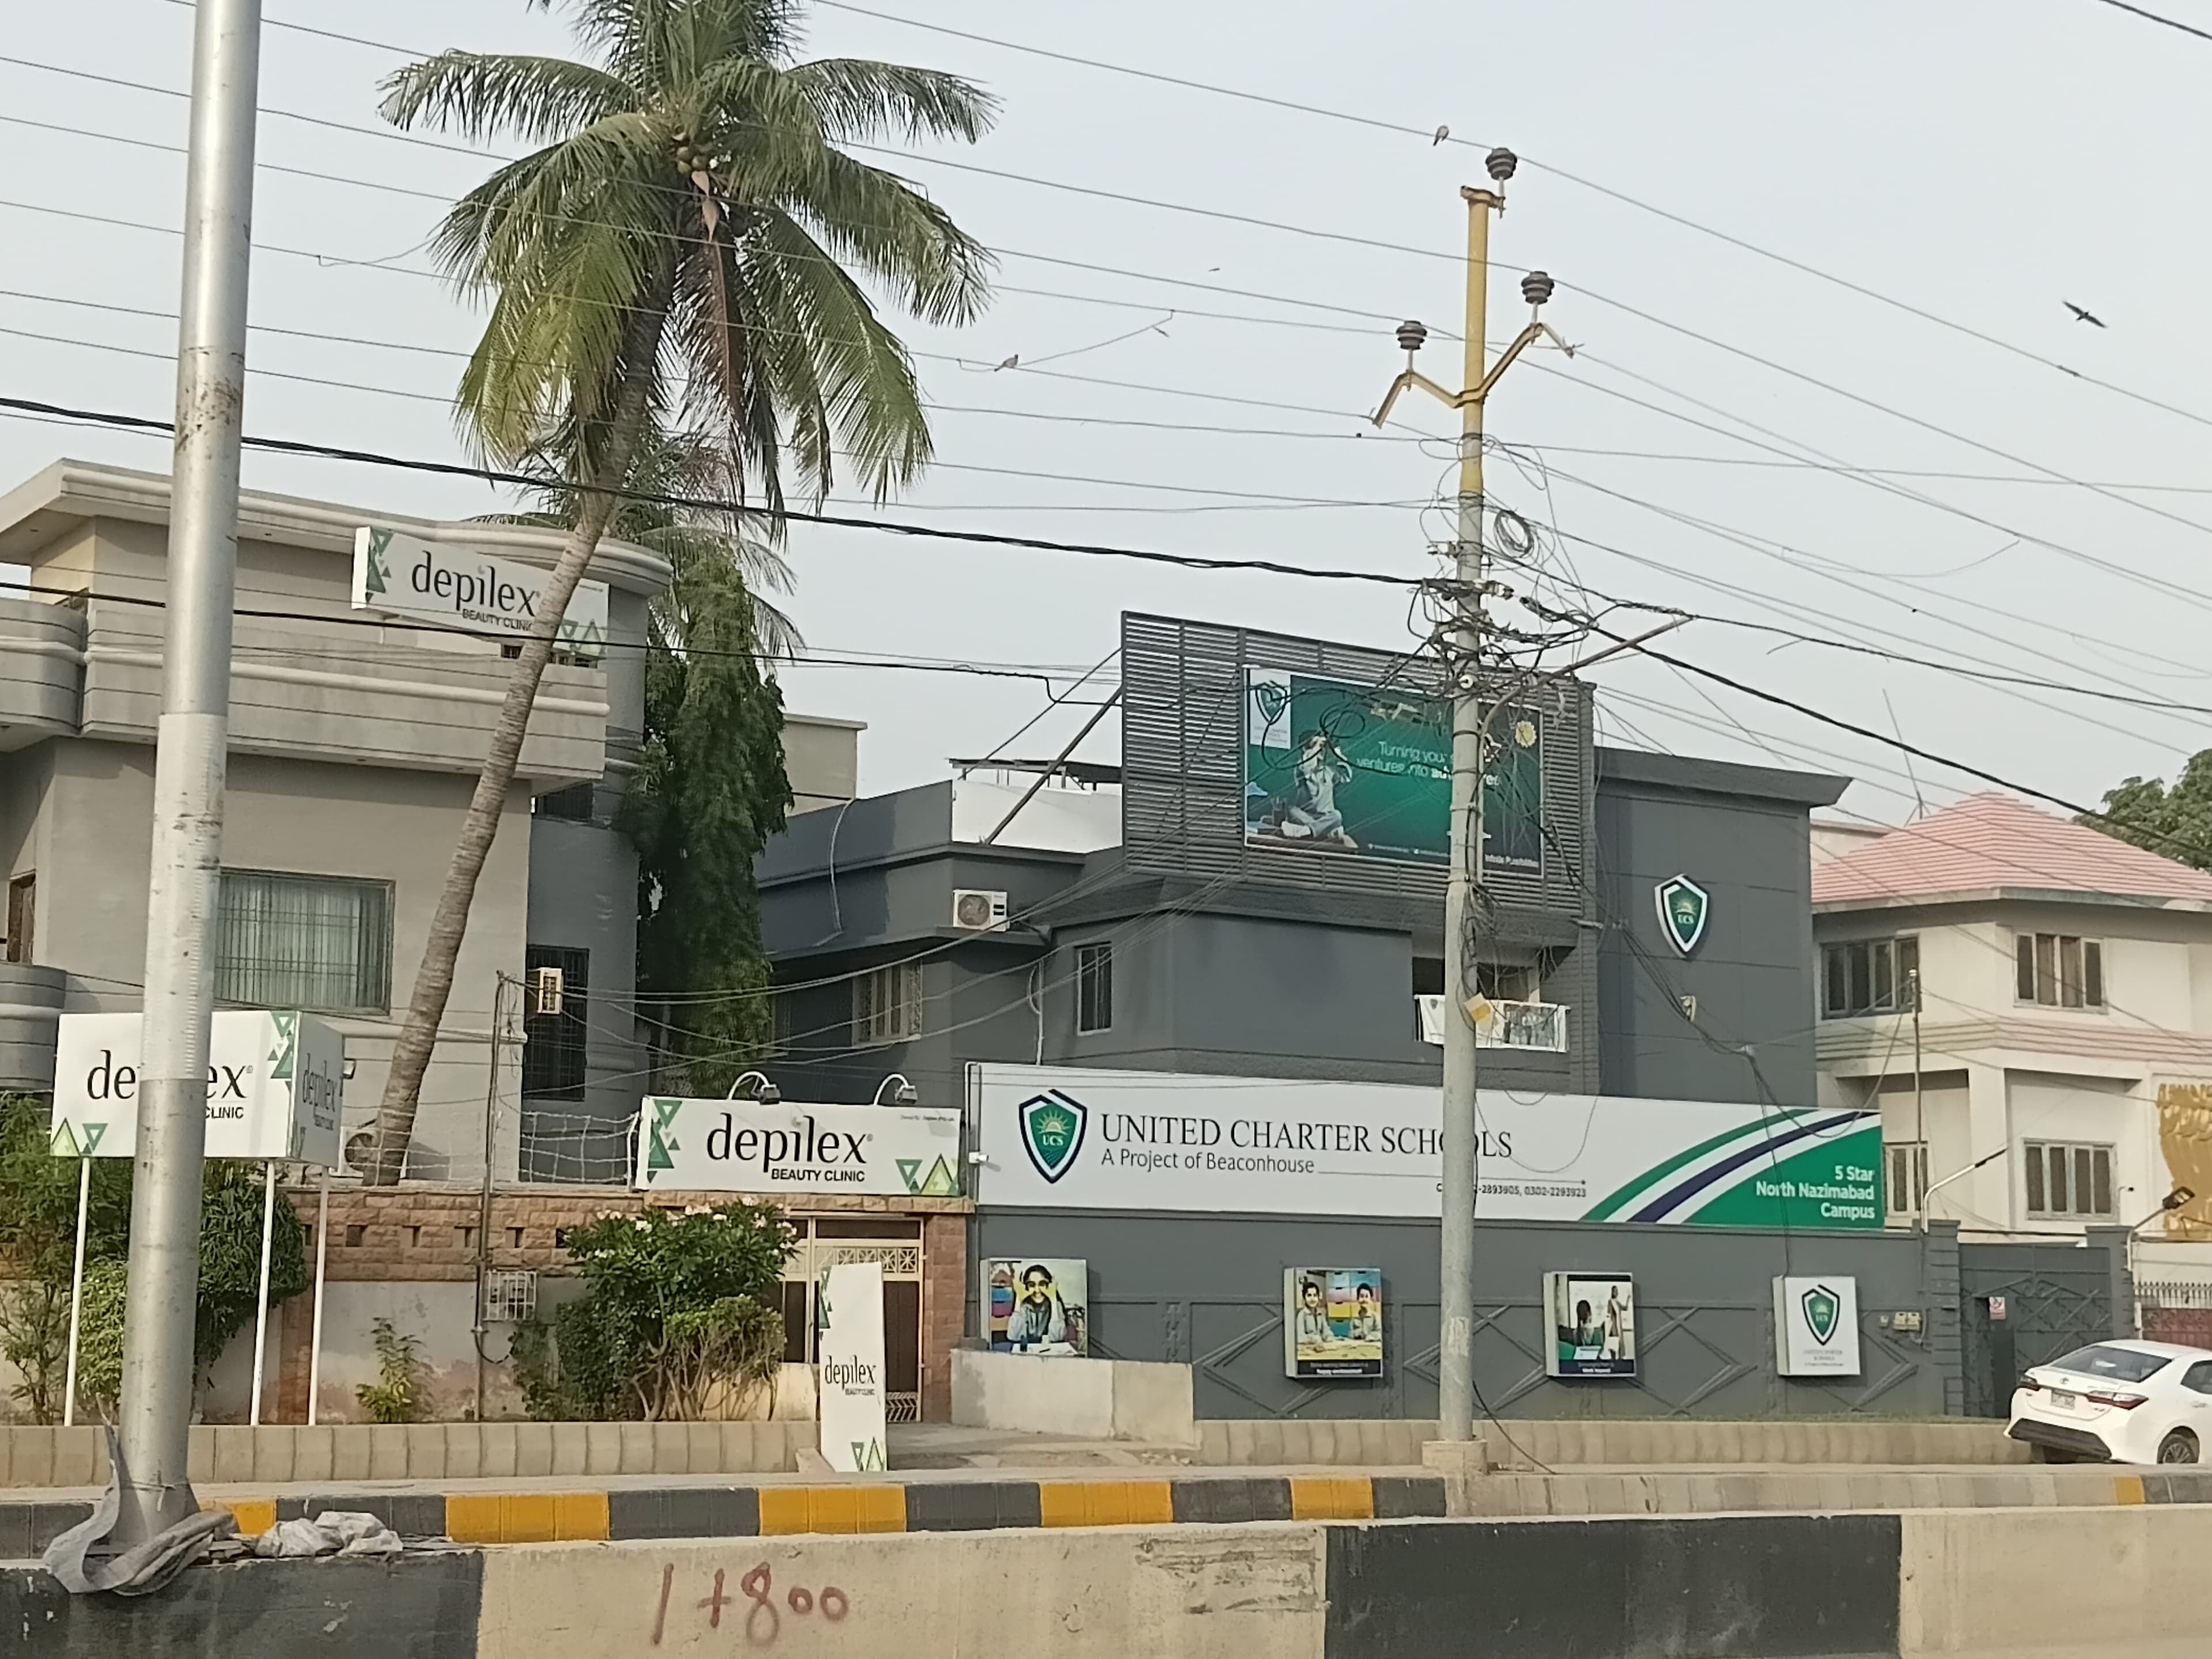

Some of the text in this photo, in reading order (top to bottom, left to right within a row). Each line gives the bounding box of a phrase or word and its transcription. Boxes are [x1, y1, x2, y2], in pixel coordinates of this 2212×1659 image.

[412, 550, 536, 617] depilex
[462, 608, 500, 626] BEAUTY
[707, 1112, 867, 1173] depilex
[1042, 1135, 1064, 1146] UCS
[1101, 1113, 1512, 1158] UNITED CHARTER SCHLS
[1102, 1149, 1315, 1173] A Project of Beaconhouse
[771, 1168, 865, 1182] BEAUTY CLINIC
[1834, 1165, 1875, 1181] 5 Star
[1756, 1180, 1875, 1200] North Nazimabad
[1820, 1202, 1876, 1221] Campus
[824, 1354, 875, 1391] depilex
